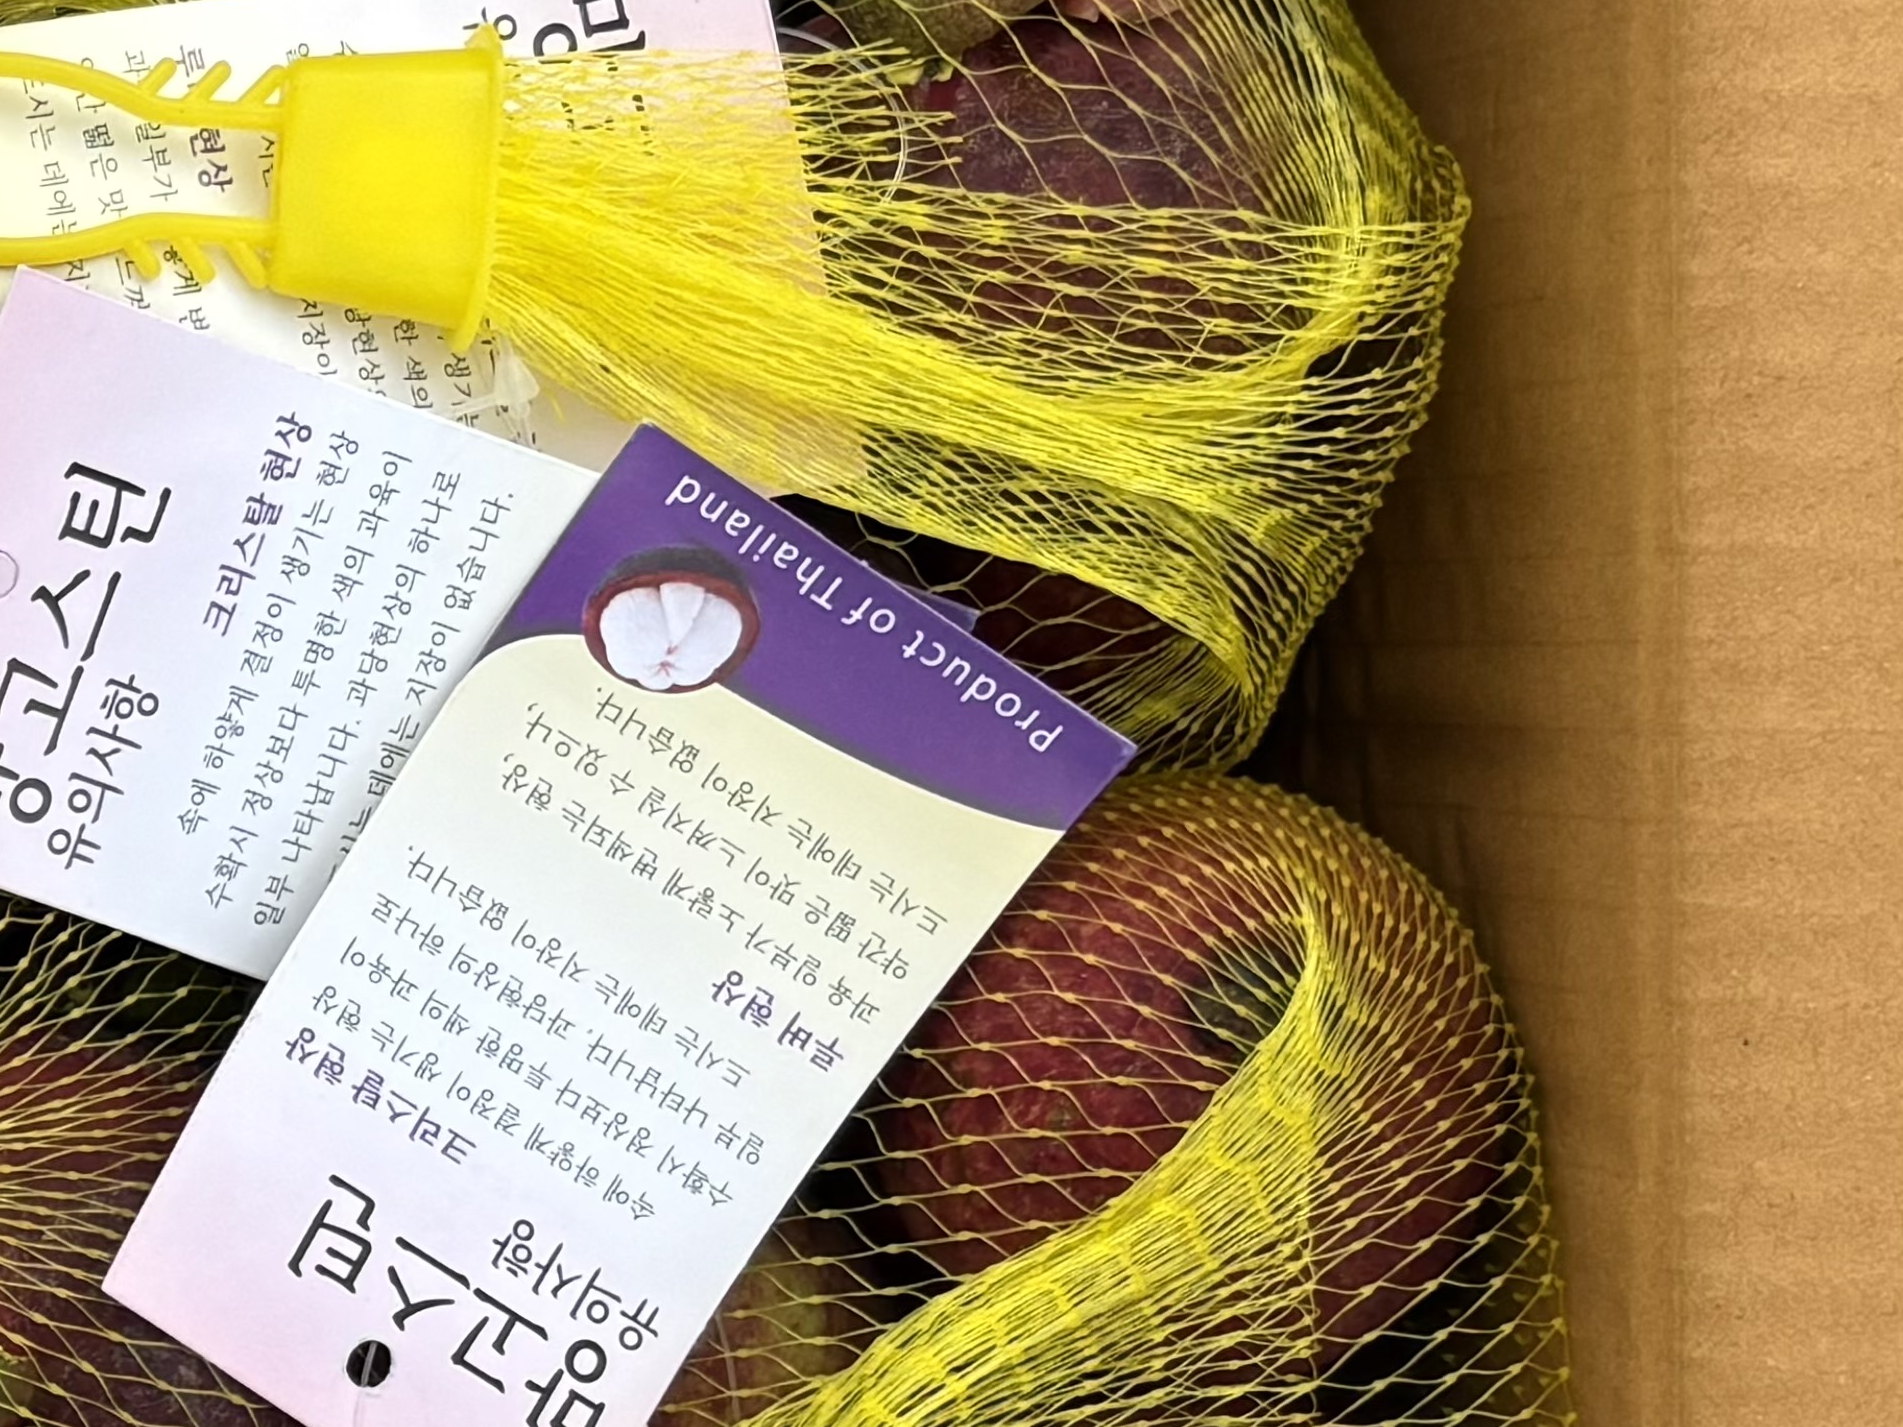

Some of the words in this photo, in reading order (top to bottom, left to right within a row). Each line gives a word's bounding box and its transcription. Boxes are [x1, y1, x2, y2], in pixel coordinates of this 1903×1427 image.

[133, 121, 178, 198] 일부가
[188, 127, 234, 193] 현상
[96, 188, 129, 216] 맛
[296, 297, 338, 376] 지장이
[202, 491, 284, 637] 크리스탈
[259, 410, 313, 481] 현상
[664, 474, 842, 610] Thailand
[176, 777, 222, 835] 속에
[202, 684, 260, 769] 하얗게
[239, 591, 297, 676] 결정이
[279, 497, 334, 583] 생기는
[315, 429, 360, 487] 현상
[366, 713, 420, 798] 데에는
[404, 619, 461, 706] 지장이
[443, 492, 514, 610] 없습니다.
[840, 596, 896, 633] of
[204, 824, 259, 909] 수확시
[240, 703, 309, 816] 정상보다
[290, 609, 348, 696] 투명한
[331, 543, 375, 602] 색의
[356, 449, 413, 538] 과육이
[252, 873, 295, 926] 일부
[280, 719, 361, 863] 나타납니다.
[345, 562, 427, 707] 과당현상의
[406, 470, 461, 554] 하나로
[901, 629, 1063, 752] Product
[524, 701, 607, 777] 있으나,
[594, 686, 700, 773] 없습니다.
[46, 673, 160, 870] 유의사항
[501, 752, 553, 811] 현상,
[608, 768, 635, 795] 수
[699, 761, 782, 827] 지장이
[560, 798, 658, 881] 변색되는
[636, 784, 746, 867] 느껴지실
[786, 816, 862, 880] 데에는
[406, 844, 510, 931] 없습니다.
[660, 866, 745, 933] 노랗게
[742, 855, 801, 906] 맛이
[868, 870, 948, 935] 드시는
[369, 891, 444, 956] 하나로
[509, 918, 588, 983] 지장이
[803, 893, 857, 943] 떫은
[338, 935, 419, 1002] 과육이
[743, 921, 822, 986] 일부가
[856, 930, 909, 979] 약간
[311, 984, 361, 1032] 현상
[418, 988, 470, 1036] 색의
[447, 942, 576, 1040] 과당현상의
[594, 972, 668, 1035] 데에는
[710, 969, 775, 1028] 현상
[827, 974, 880, 1024] 과육
[284, 1025, 346, 1085] 현상
[370, 1019, 442, 1082] 생기는
[474, 1024, 552, 1090] 투명한
[673, 1024, 751, 1087] 드시는
[776, 1010, 844, 1072] 루버
[445, 1069, 521, 1137] 결정이
[585, 1027, 709, 1129] 나타납니다.
[350, 1067, 477, 1165] 크리스탈
[553, 1076, 653, 1158] 정상보다
[713, 1120, 764, 1165] 일부
[522, 1121, 600, 1188] 하얗게
[655, 1143, 733, 1206] 수확시
[601, 1172, 655, 1220] 속에
[490, 1217, 659, 1351] 유의사항
